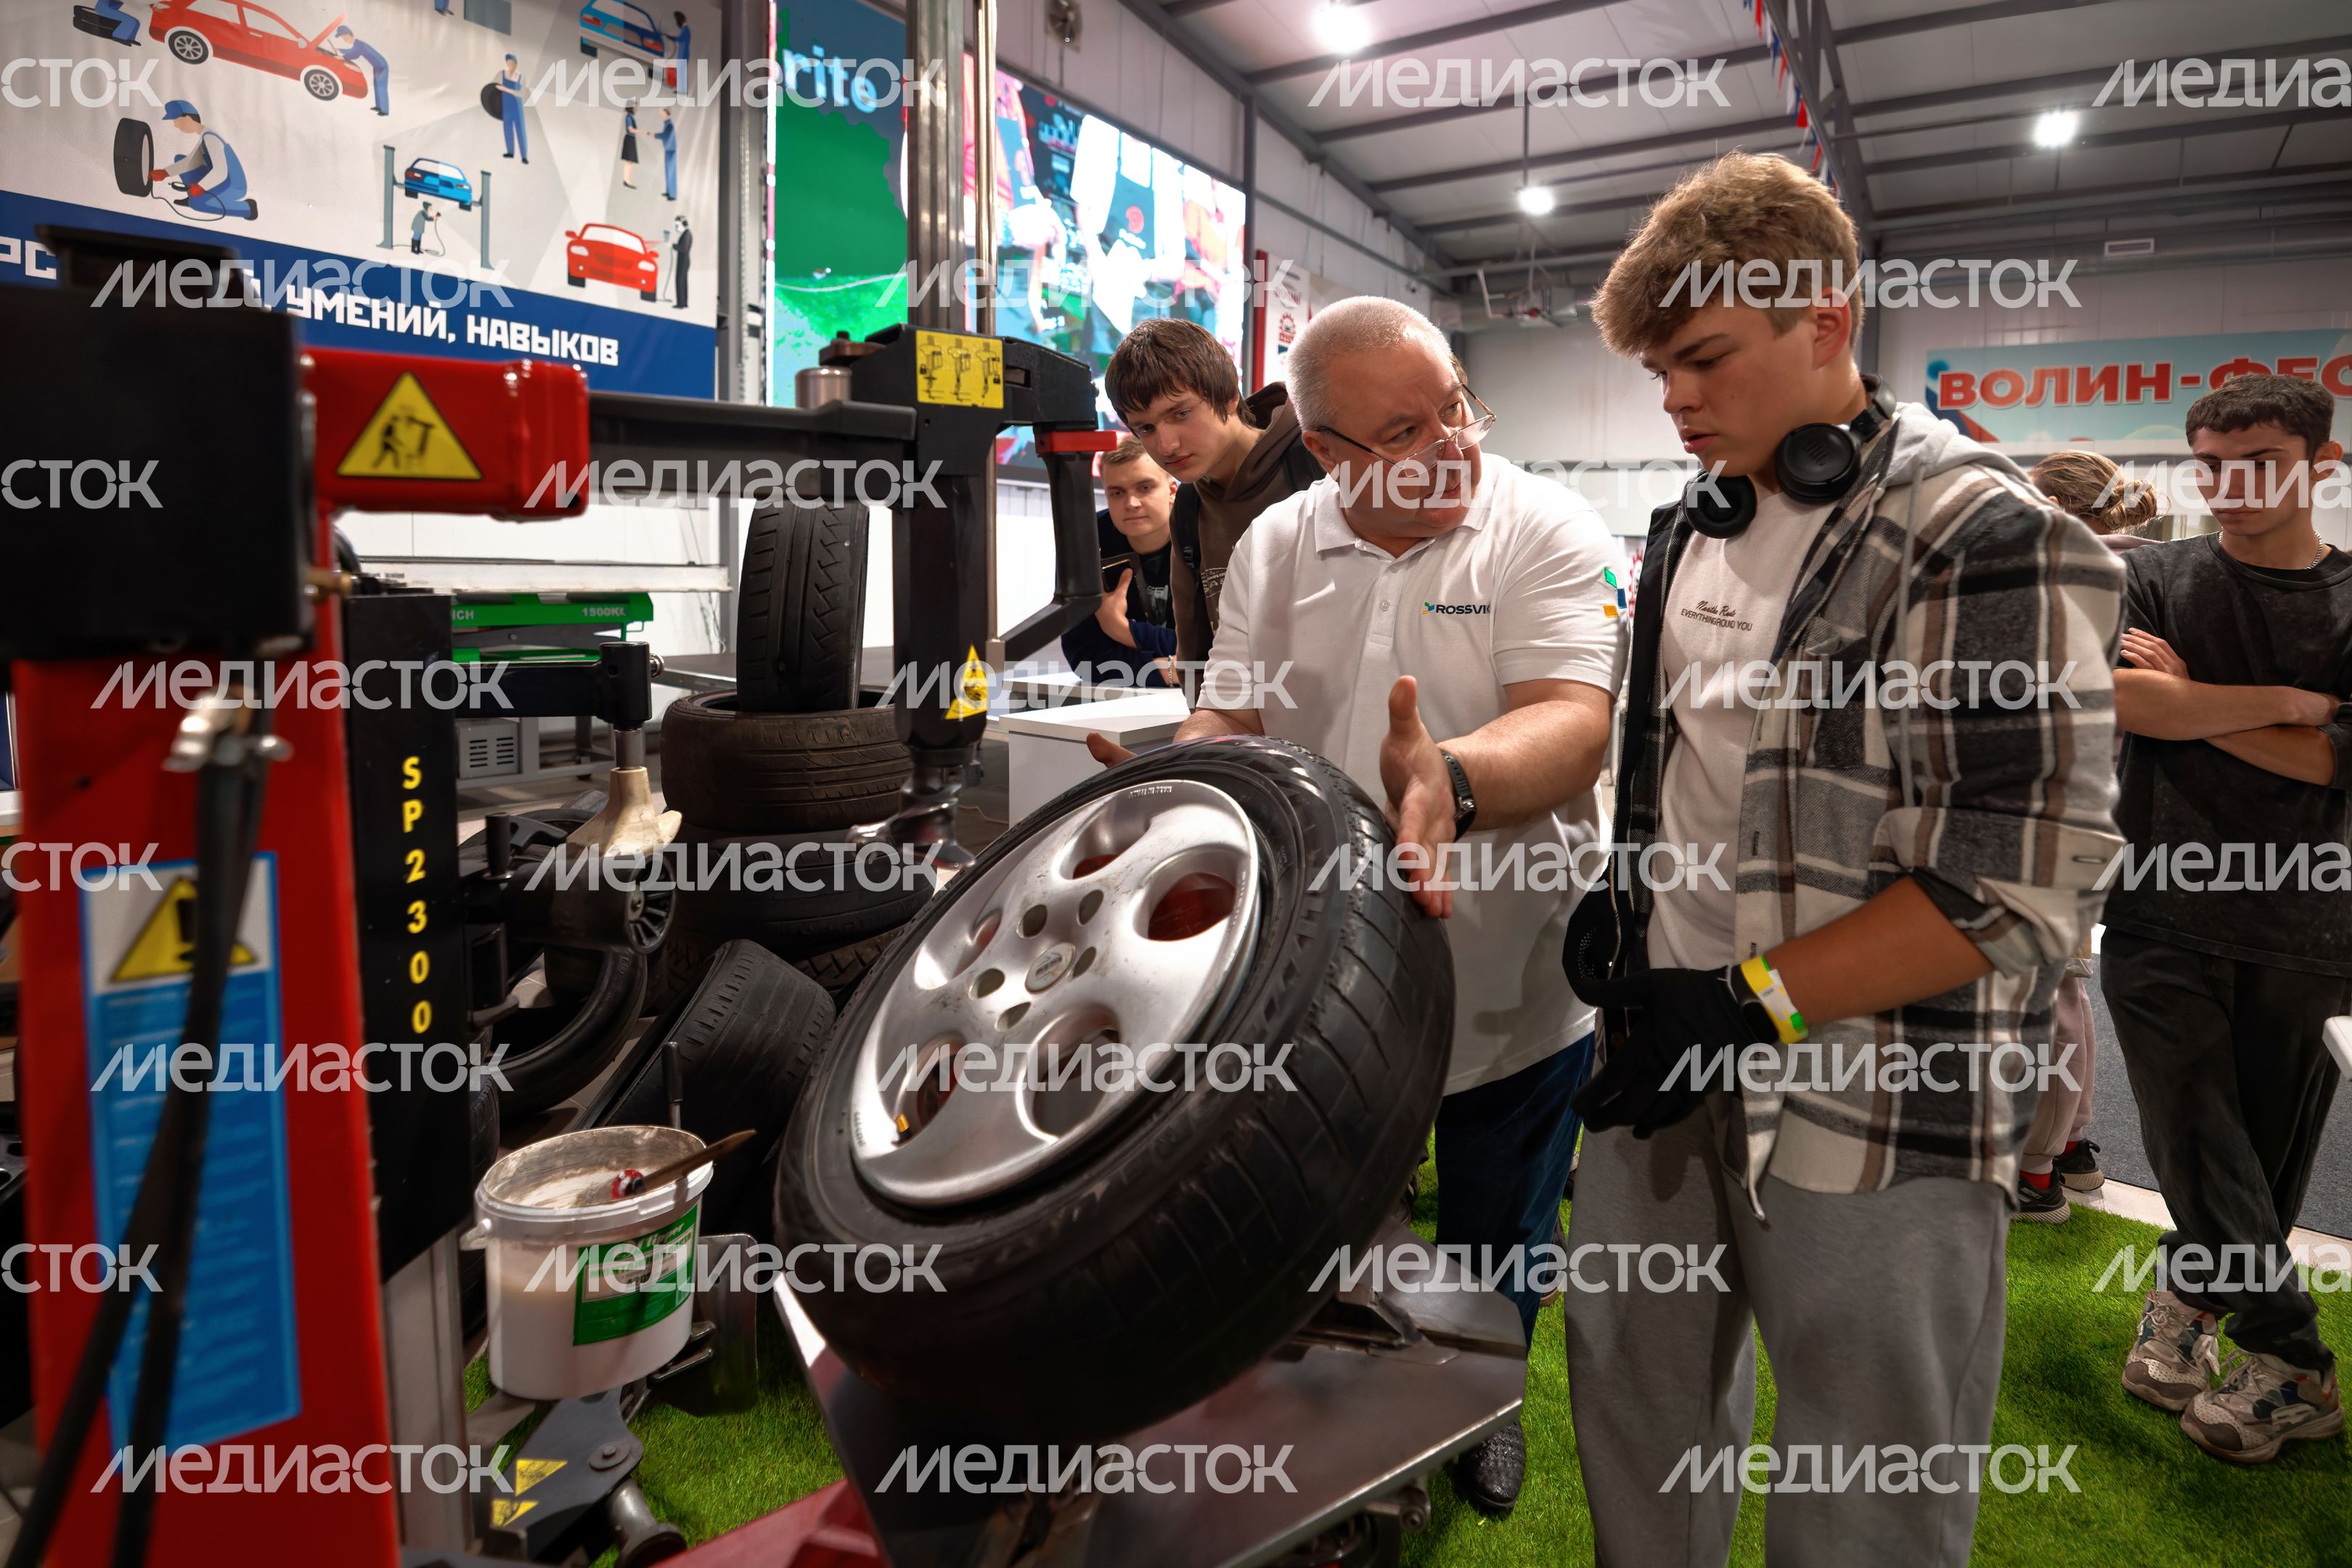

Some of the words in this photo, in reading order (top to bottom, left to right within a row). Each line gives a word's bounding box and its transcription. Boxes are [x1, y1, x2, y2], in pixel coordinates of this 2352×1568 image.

[286, 284, 456, 344] УМЕНИЙ,
[467, 314, 619, 367] НАВЫКОВ
[1736, 621, 1753, 632] YOU
